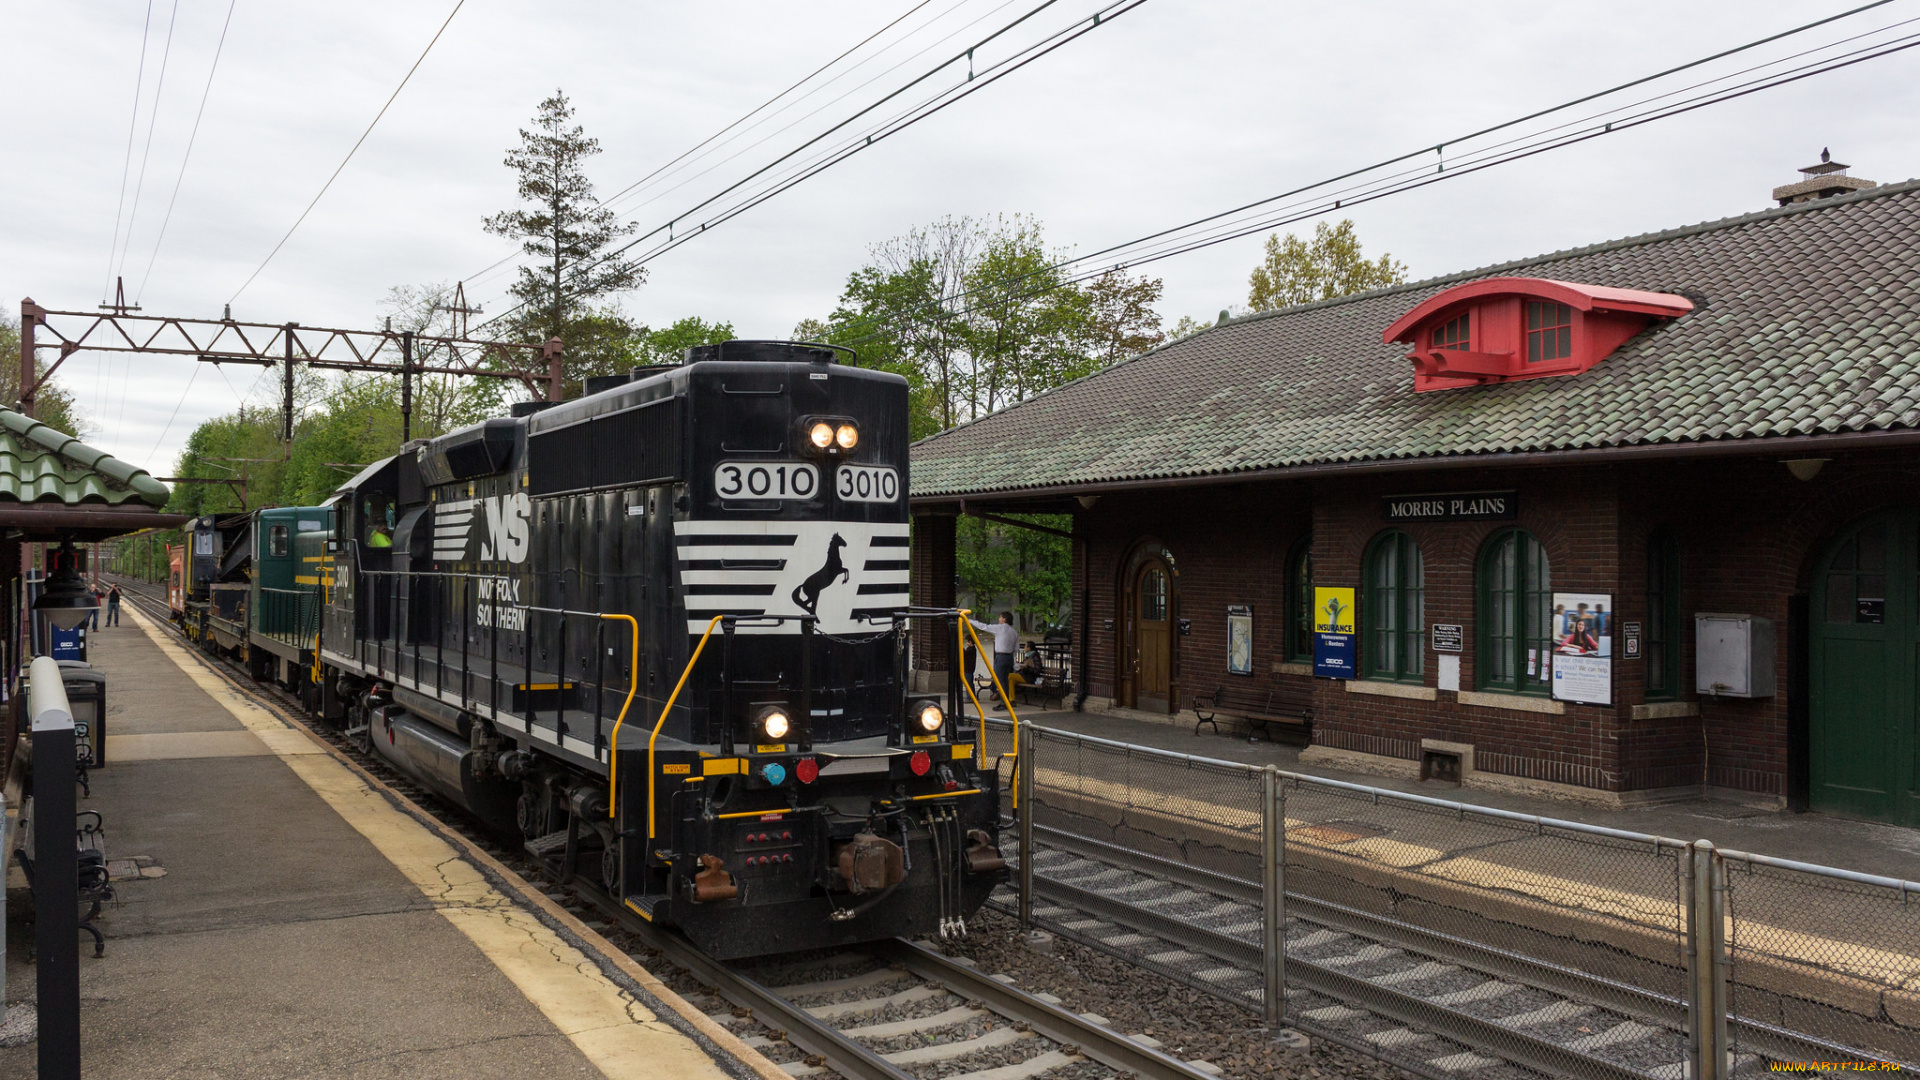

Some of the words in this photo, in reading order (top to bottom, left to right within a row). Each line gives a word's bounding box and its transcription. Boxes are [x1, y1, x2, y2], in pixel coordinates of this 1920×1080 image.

[720, 466, 814, 496] 3010
[839, 468, 896, 499] 3010
[1391, 500, 1445, 517] MORRIS
[1450, 498, 1505, 515] PLAINS
[480, 492, 531, 564] NS
[336, 565, 349, 588] 3010
[478, 578, 521, 602] NOFOLK
[1316, 623, 1352, 633] INSURANCE
